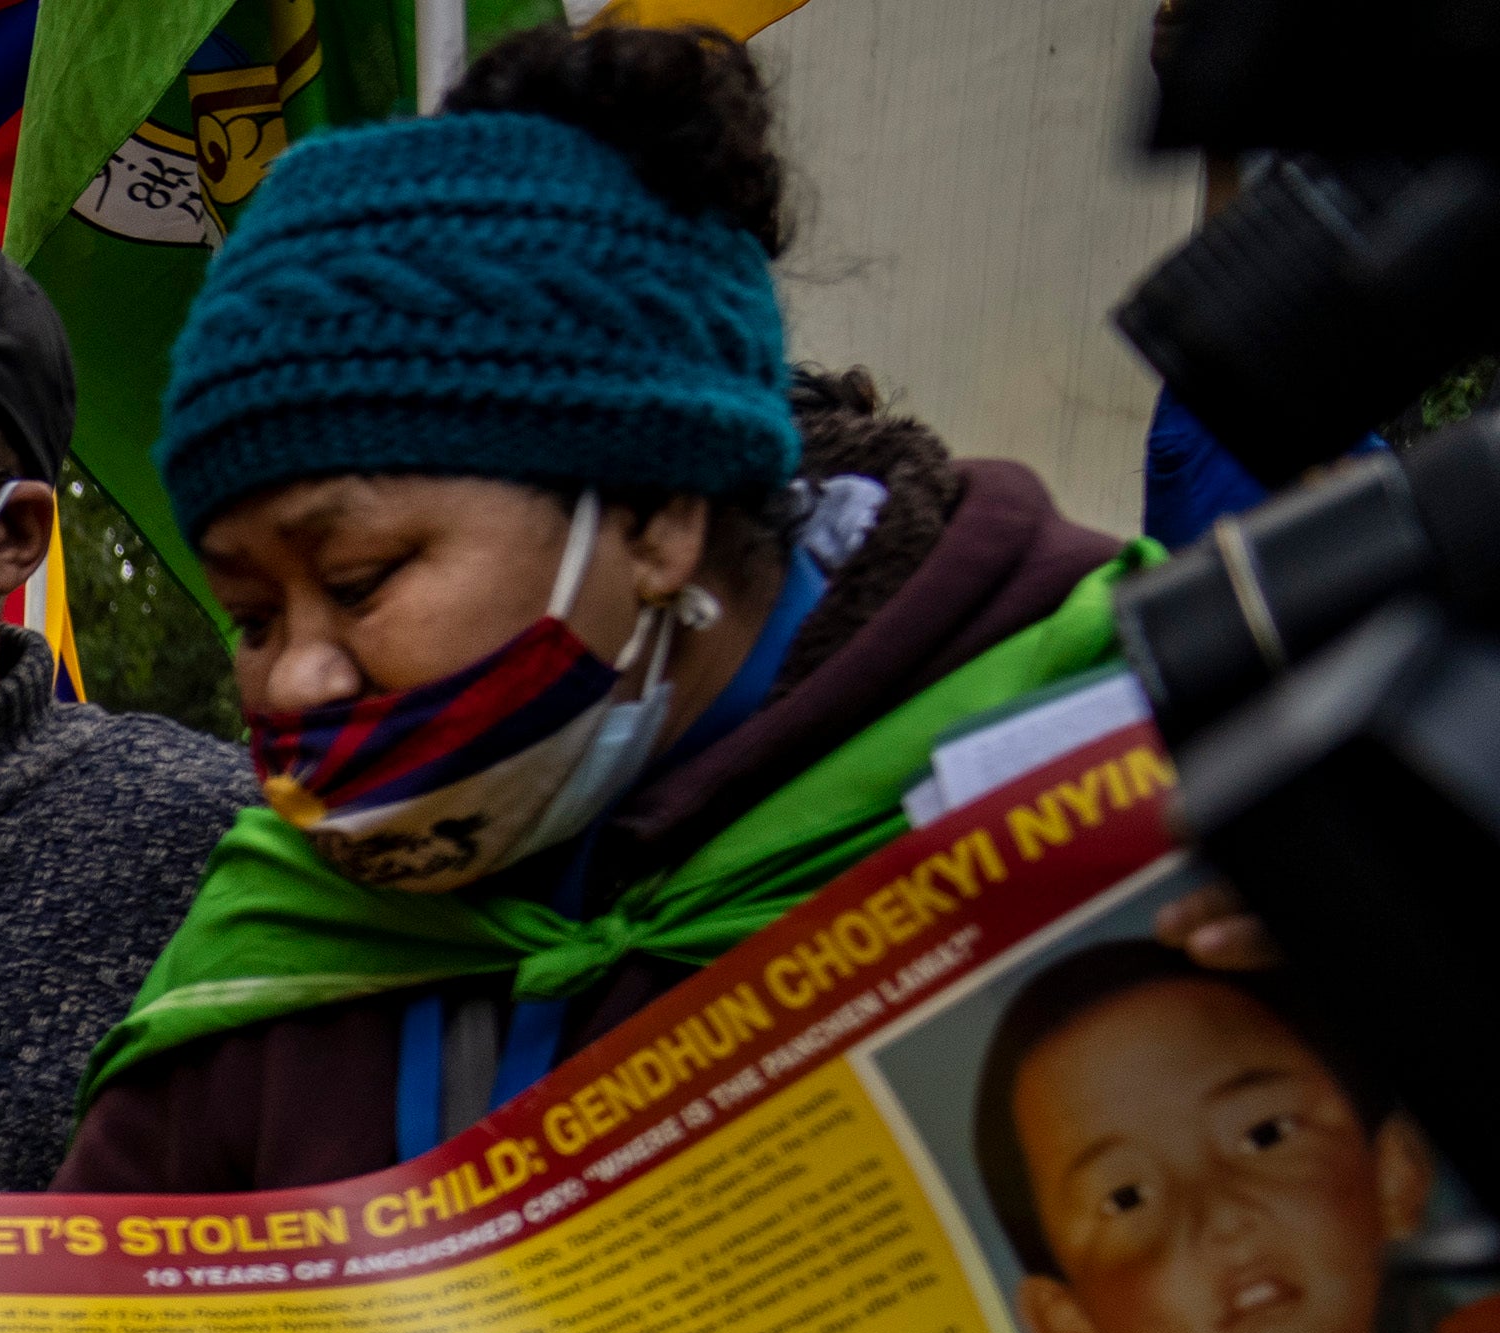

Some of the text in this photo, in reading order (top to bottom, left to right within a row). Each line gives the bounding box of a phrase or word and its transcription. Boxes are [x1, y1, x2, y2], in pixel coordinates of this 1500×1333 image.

[116, 1203, 351, 1257] STOLEN
[362, 1137, 548, 1239] CHILD:
[542, 980, 775, 1156] GENDHUN
[762, 828, 1009, 1011] CHOEKYI
[187, 1262, 289, 1287] YEARS
[294, 1259, 338, 1281] OF
[342, 1210, 524, 1278] ANGUISHED
[678, 1097, 717, 1130] IS
[706, 1063, 768, 1110] THE
[759, 990, 887, 1079] PANCHEN
